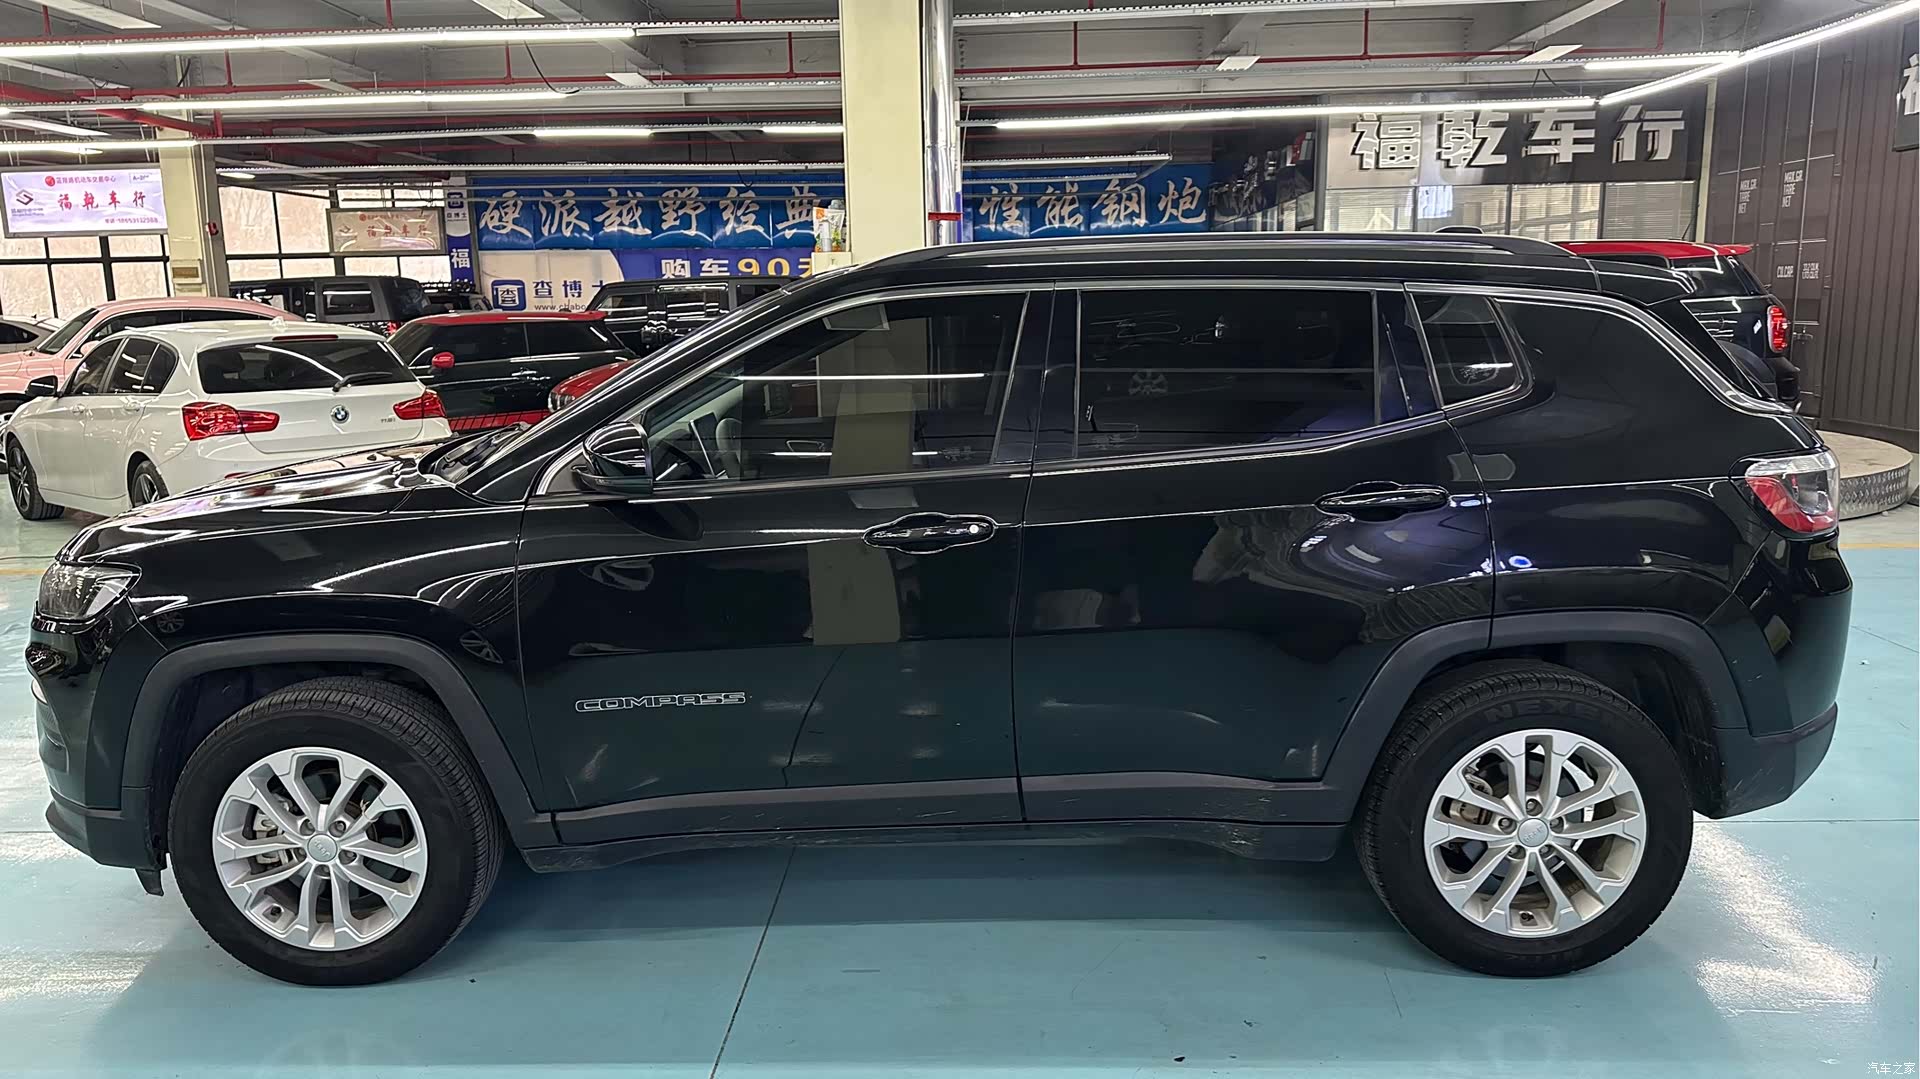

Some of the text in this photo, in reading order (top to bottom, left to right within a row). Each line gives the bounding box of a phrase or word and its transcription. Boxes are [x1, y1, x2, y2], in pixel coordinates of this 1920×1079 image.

[1351, 104, 1686, 169] 福乾车行
[58, 190, 146, 211] 福乾车行
[575, 692, 746, 712] COMPASS
